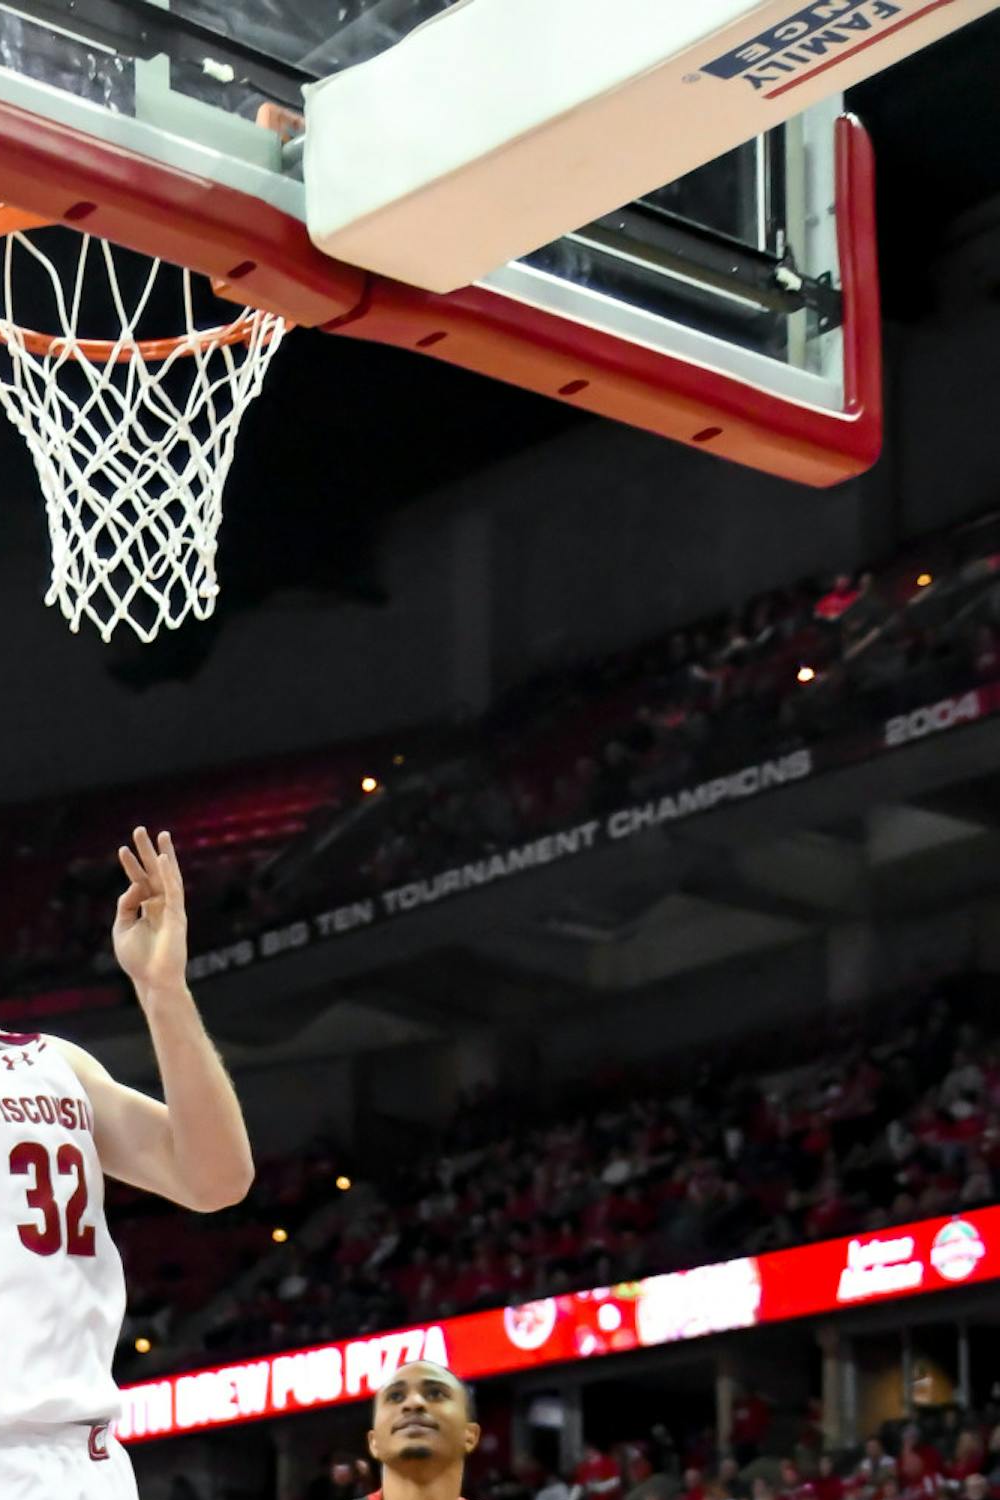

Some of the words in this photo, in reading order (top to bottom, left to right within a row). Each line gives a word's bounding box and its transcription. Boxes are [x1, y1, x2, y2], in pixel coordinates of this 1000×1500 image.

[742, 1, 902, 90] FAMILY
[884, 691, 979, 746] 2004
[187, 940, 254, 980] EN'S
[261, 921, 310, 956] BIG
[316, 898, 374, 936] TEN
[382, 820, 599, 915] TOURNAMENT
[607, 749, 812, 839] CHAMPIONS
[9, 1141, 96, 1257] 32
[271, 1347, 343, 1410] PUB
